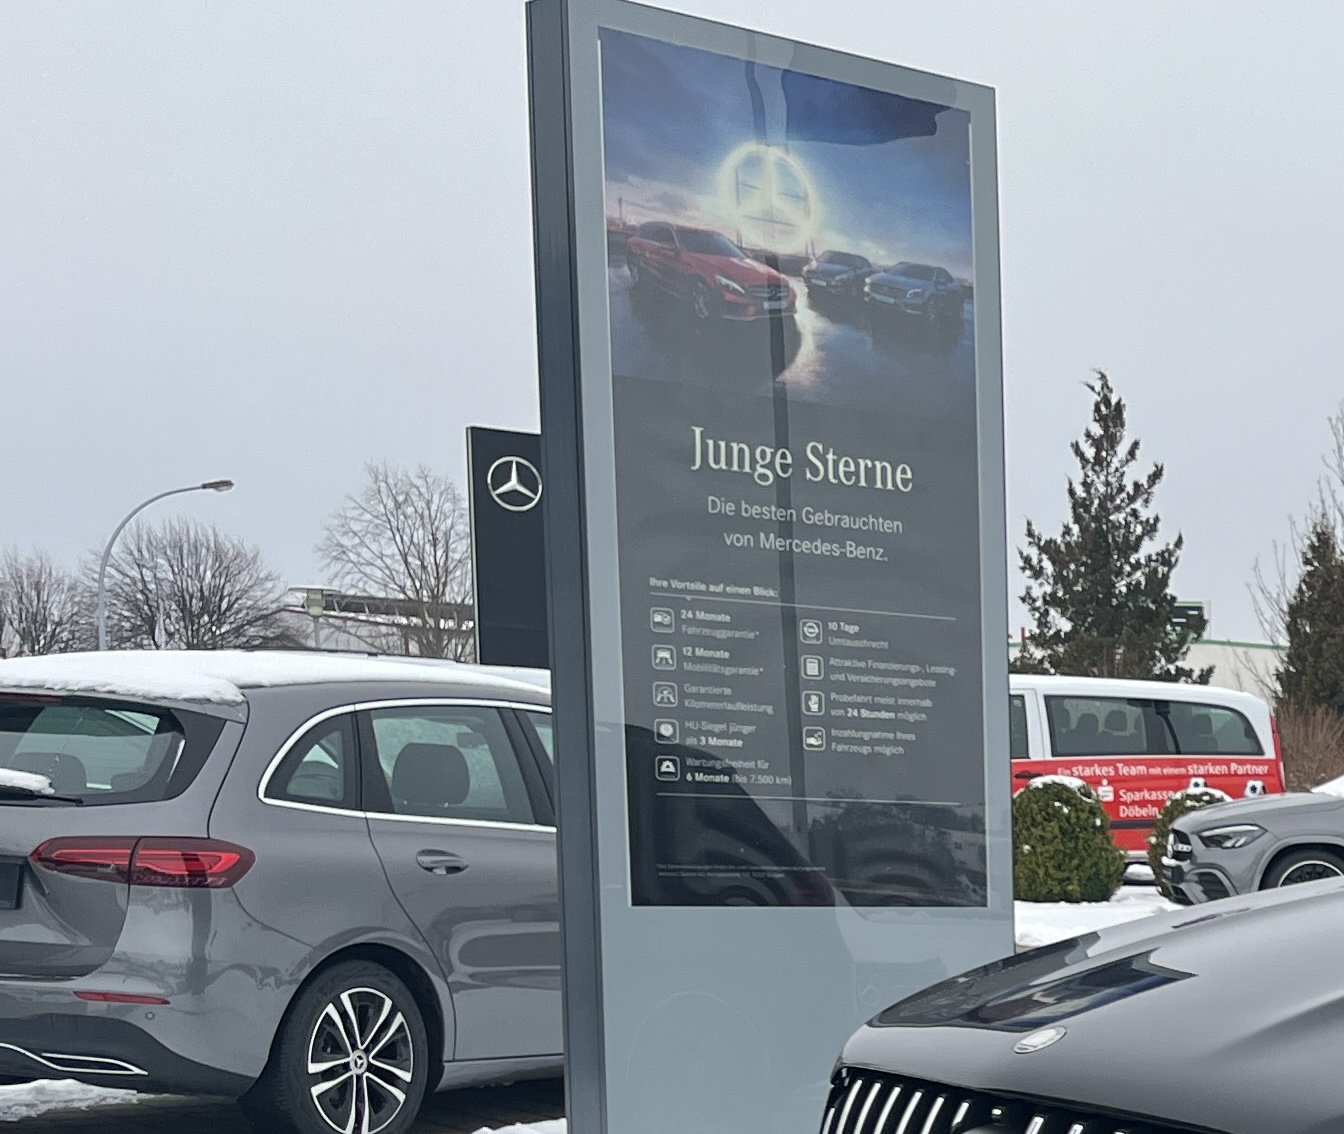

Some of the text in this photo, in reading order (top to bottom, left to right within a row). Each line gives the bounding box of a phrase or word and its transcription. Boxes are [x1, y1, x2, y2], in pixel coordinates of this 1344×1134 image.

[690, 426, 913, 492] Junge Sterne
[707, 496, 903, 534] Die besten Gebrauchten
[723, 532, 888, 562] von Mercedes-Benz.
[650, 577, 668, 588] Ihre
[670, 579, 707, 592] Vorteile
[709, 583, 724, 593] auf
[726, 585, 751, 594] einen
[680, 609, 731, 622] 24 Monate
[827, 622, 860, 634] 10 Tage
[682, 647, 730, 659] 12 Monate
[847, 708, 858, 717] 24
[700, 736, 706, 745] 3
[708, 736, 743, 747] Monate
[1072, 763, 1115, 776] starkes
[1116, 762, 1147, 776] Team
[1187, 762, 1228, 775] starken
[1230, 762, 1269, 775] Partner
[686, 772, 692, 782] 6
[695, 772, 730, 783] Monate
[750, 774, 774, 784] 7.500
[775, 774, 792, 785] km)
[1119, 804, 1159, 818] Döbeln
